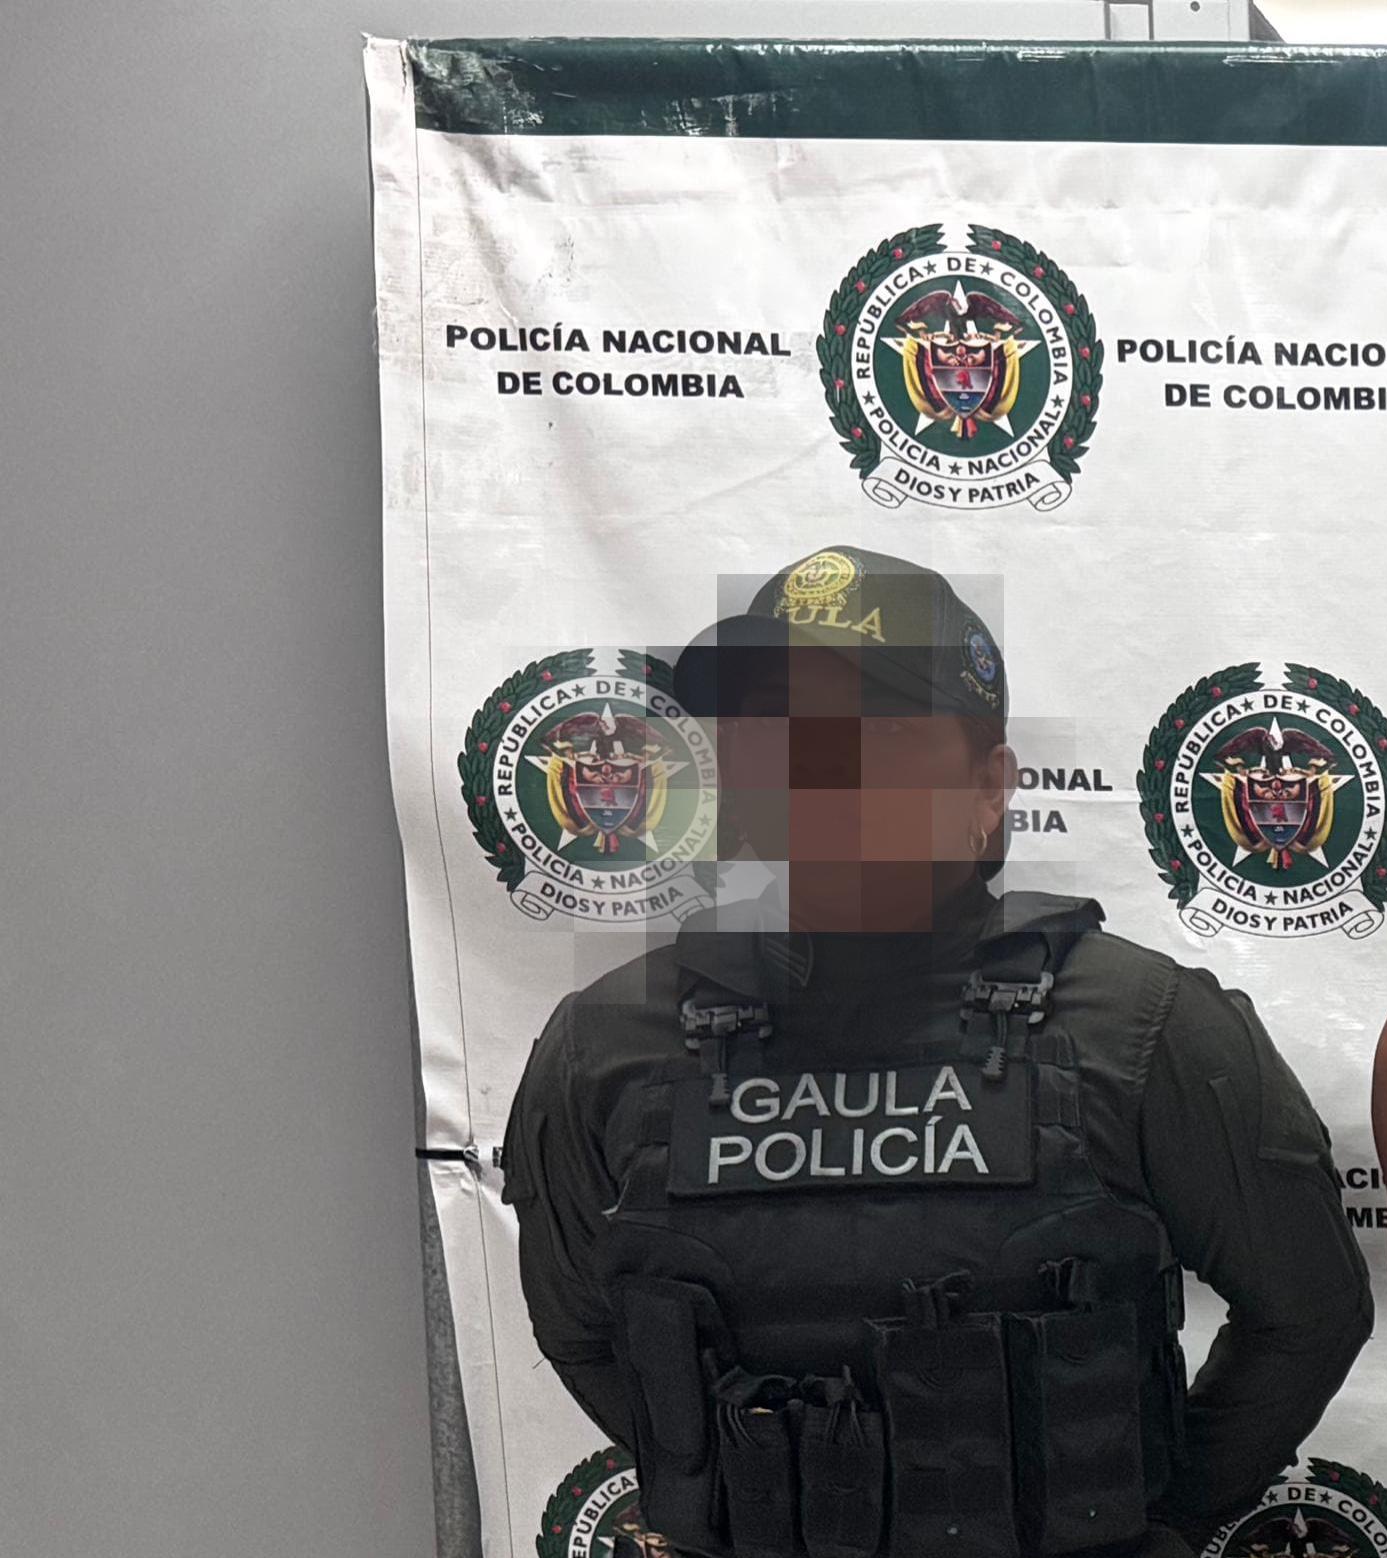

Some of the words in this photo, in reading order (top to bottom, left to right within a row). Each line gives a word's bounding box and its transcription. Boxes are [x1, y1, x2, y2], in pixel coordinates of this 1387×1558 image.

[447, 322, 589, 351] POLICÍA
[603, 330, 791, 356] NACIONAL
[948, 258, 975, 272] DE
[1001, 273, 1067, 384] COLOMBIA
[1117, 335, 1262, 365] POLICÍA
[498, 372, 542, 395] DE
[552, 371, 744, 398] COLOMBIA
[1165, 384, 1210, 407] DE
[968, 412, 1059, 474] NACIONAL
[969, 473, 1039, 502] PATRIA
[788, 604, 886, 643] ULA
[597, 682, 625, 695] DE
[651, 697, 716, 803] COLOMBIA
[1265, 696, 1291, 709] DE
[1316, 710, 1380, 817] COLOMBIA
[611, 830, 706, 888] NACIONAL
[1283, 844, 1372, 904] NACIONAL
[612, 887, 683, 915] PATRIA
[1284, 902, 1352, 930] PATRIA
[730, 1065, 973, 1123] GAULA
[706, 1116, 989, 1184] POLICÍA
[1289, 1488, 1314, 1501] DE
